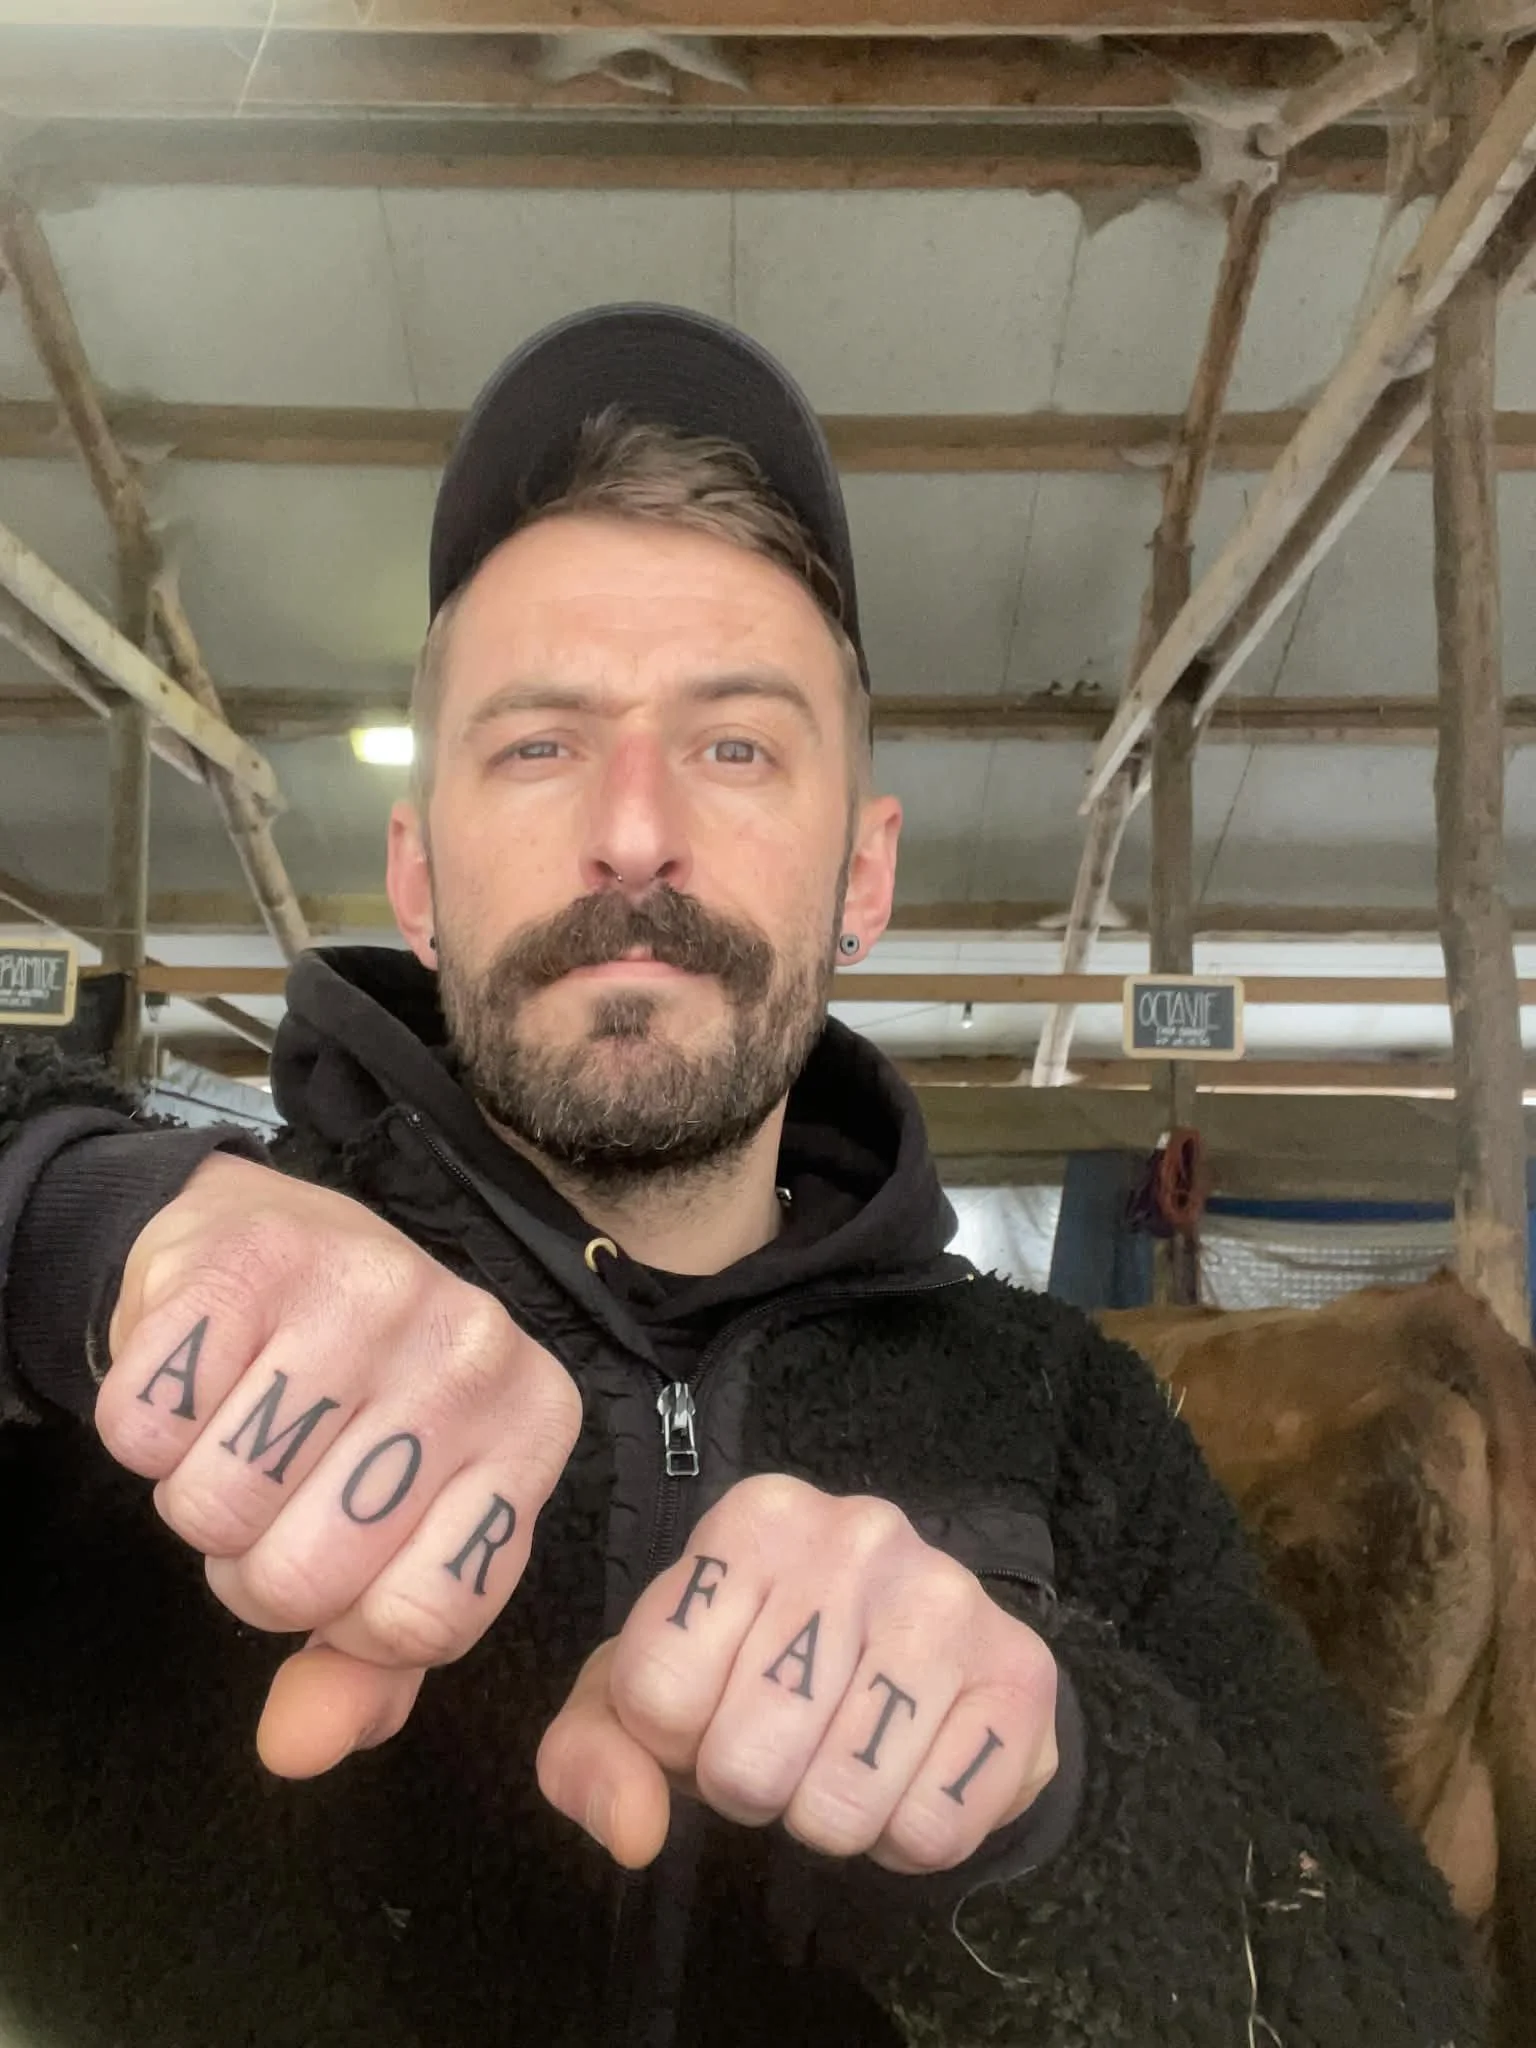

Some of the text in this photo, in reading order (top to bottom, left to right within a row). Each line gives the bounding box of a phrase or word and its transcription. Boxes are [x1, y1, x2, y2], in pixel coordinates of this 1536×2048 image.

[1139, 991, 1220, 1030] OCTAVIE
[136, 1315, 517, 1596] AMOR
[666, 1555, 1004, 1806] FATI
